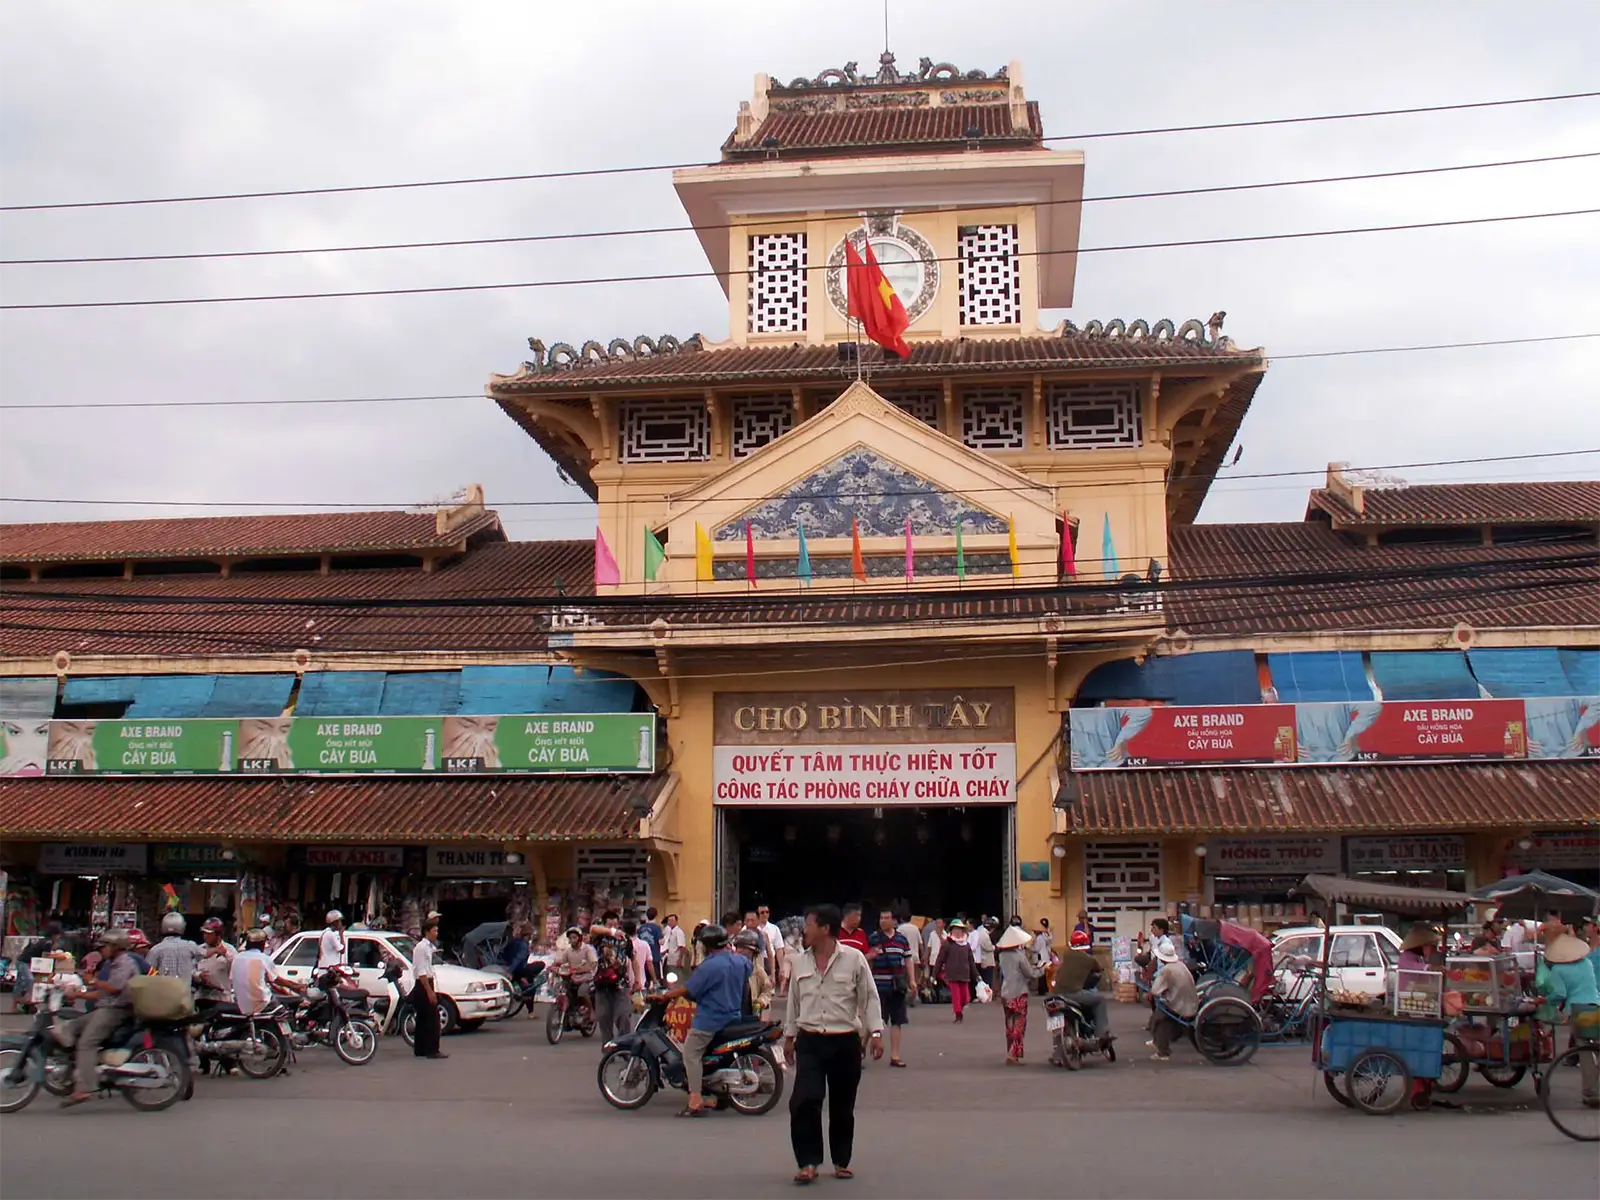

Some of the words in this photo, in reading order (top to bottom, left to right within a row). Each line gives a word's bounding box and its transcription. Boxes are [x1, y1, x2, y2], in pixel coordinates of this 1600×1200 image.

[734, 702, 807, 737] CHỢ
[818, 698, 912, 730] BÌNH
[923, 695, 992, 729] TÂY
[1174, 716, 1198, 728] AXE
[1202, 714, 1244, 727] BRAND
[1403, 710, 1428, 722] AXE
[1431, 708, 1474, 721] BRAND
[120, 726, 142, 738] AXE
[145, 726, 183, 738] BRAND
[317, 724, 340, 736] AXE
[343, 723, 382, 735] BRAND
[525, 722, 549, 734] AXE
[553, 721, 594, 733] BRAND
[1188, 736, 1209, 750] CÂY
[1418, 730, 1441, 744] CÂY
[122, 749, 148, 765] CÂY
[319, 748, 345, 764] CÂY
[528, 746, 556, 763] CÂY
[560, 746, 589, 762] BÚA
[732, 748, 794, 774] QUYẾT
[800, 751, 842, 772] TÂM
[849, 751, 901, 774] THỰC
[908, 749, 952, 774] HIỆN
[959, 746, 997, 770] TỐT
[50, 761, 77, 770] LKF
[243, 760, 271, 769] LKF
[448, 759, 477, 768] LKF
[1127, 758, 1147, 766] LKF
[717, 778, 761, 799] CÔNG
[766, 778, 799, 799] TÁC
[804, 778, 860, 799] PHÒNG
[866, 777, 910, 798] CHÁY
[914, 776, 960, 798] CHỮA
[966, 776, 1010, 797] CHÁY
[308, 850, 342, 864] KIM
[436, 851, 485, 865] THANH
